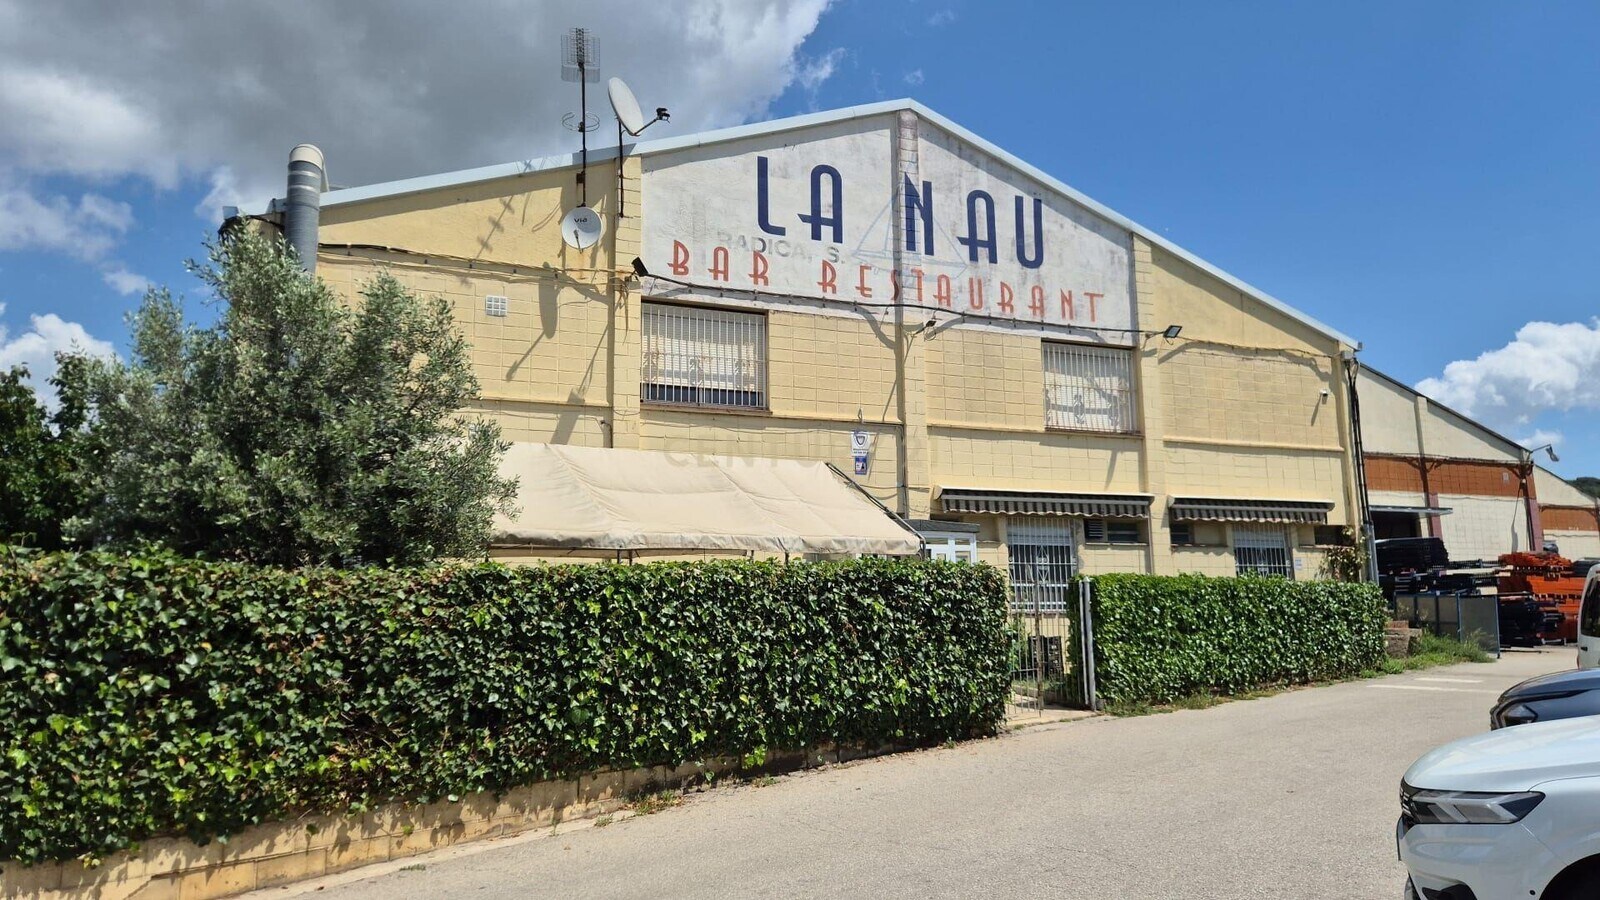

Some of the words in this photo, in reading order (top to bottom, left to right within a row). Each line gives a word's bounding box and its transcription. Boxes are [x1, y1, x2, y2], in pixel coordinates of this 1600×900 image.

[757, 156, 843, 244] LA
[904, 171, 1044, 269] NAU
[667, 240, 770, 286] BAR
[817, 259, 1105, 322] RESTAURANT
